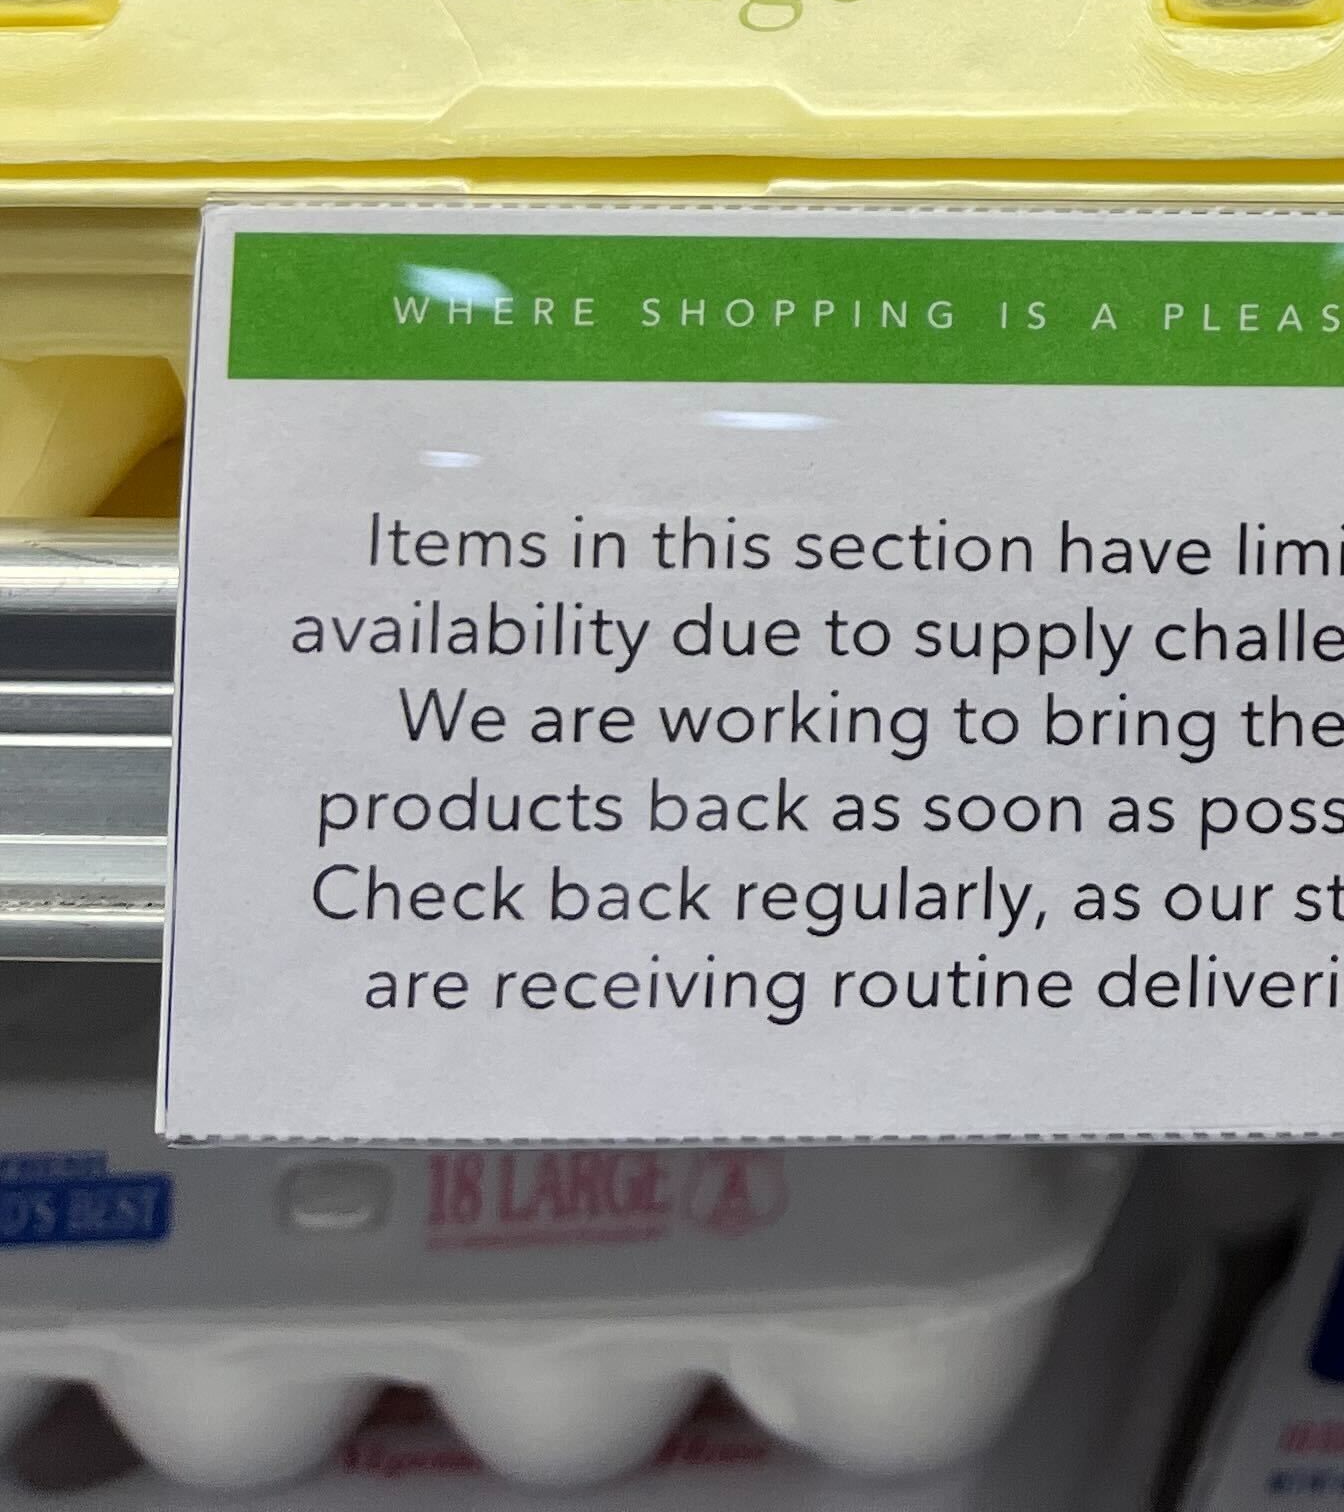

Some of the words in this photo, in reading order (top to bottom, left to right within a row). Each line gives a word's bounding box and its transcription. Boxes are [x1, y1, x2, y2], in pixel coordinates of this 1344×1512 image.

[393, 296, 595, 327] WHERE
[641, 297, 953, 329] SHOPPING
[1001, 301, 1047, 330] IS
[1091, 303, 1118, 330] A
[371, 513, 546, 568] Items
[574, 515, 625, 568] in
[653, 516, 770, 569] this
[795, 519, 1031, 572] section
[1061, 520, 1211, 575] have
[293, 600, 649, 673] availability
[673, 603, 800, 656] due
[825, 610, 890, 656] to
[915, 607, 1132, 677] supply
[400, 688, 505, 742] We
[532, 707, 634, 743] are
[659, 690, 927, 760] working
[954, 699, 1018, 744] to
[1047, 693, 1215, 763] bring
[319, 777, 622, 847] products
[651, 778, 808, 831] back
[833, 795, 899, 831] as
[924, 795, 1081, 832] soon
[1109, 797, 1174, 833] as
[313, 864, 524, 920] Check
[551, 866, 710, 920] back
[738, 866, 1046, 938] regularly,
[1074, 883, 1140, 920] as
[1165, 884, 1273, 921] our
[366, 972, 468, 1009] are
[496, 954, 805, 1025] receiving
[835, 954, 1072, 1008] routine
